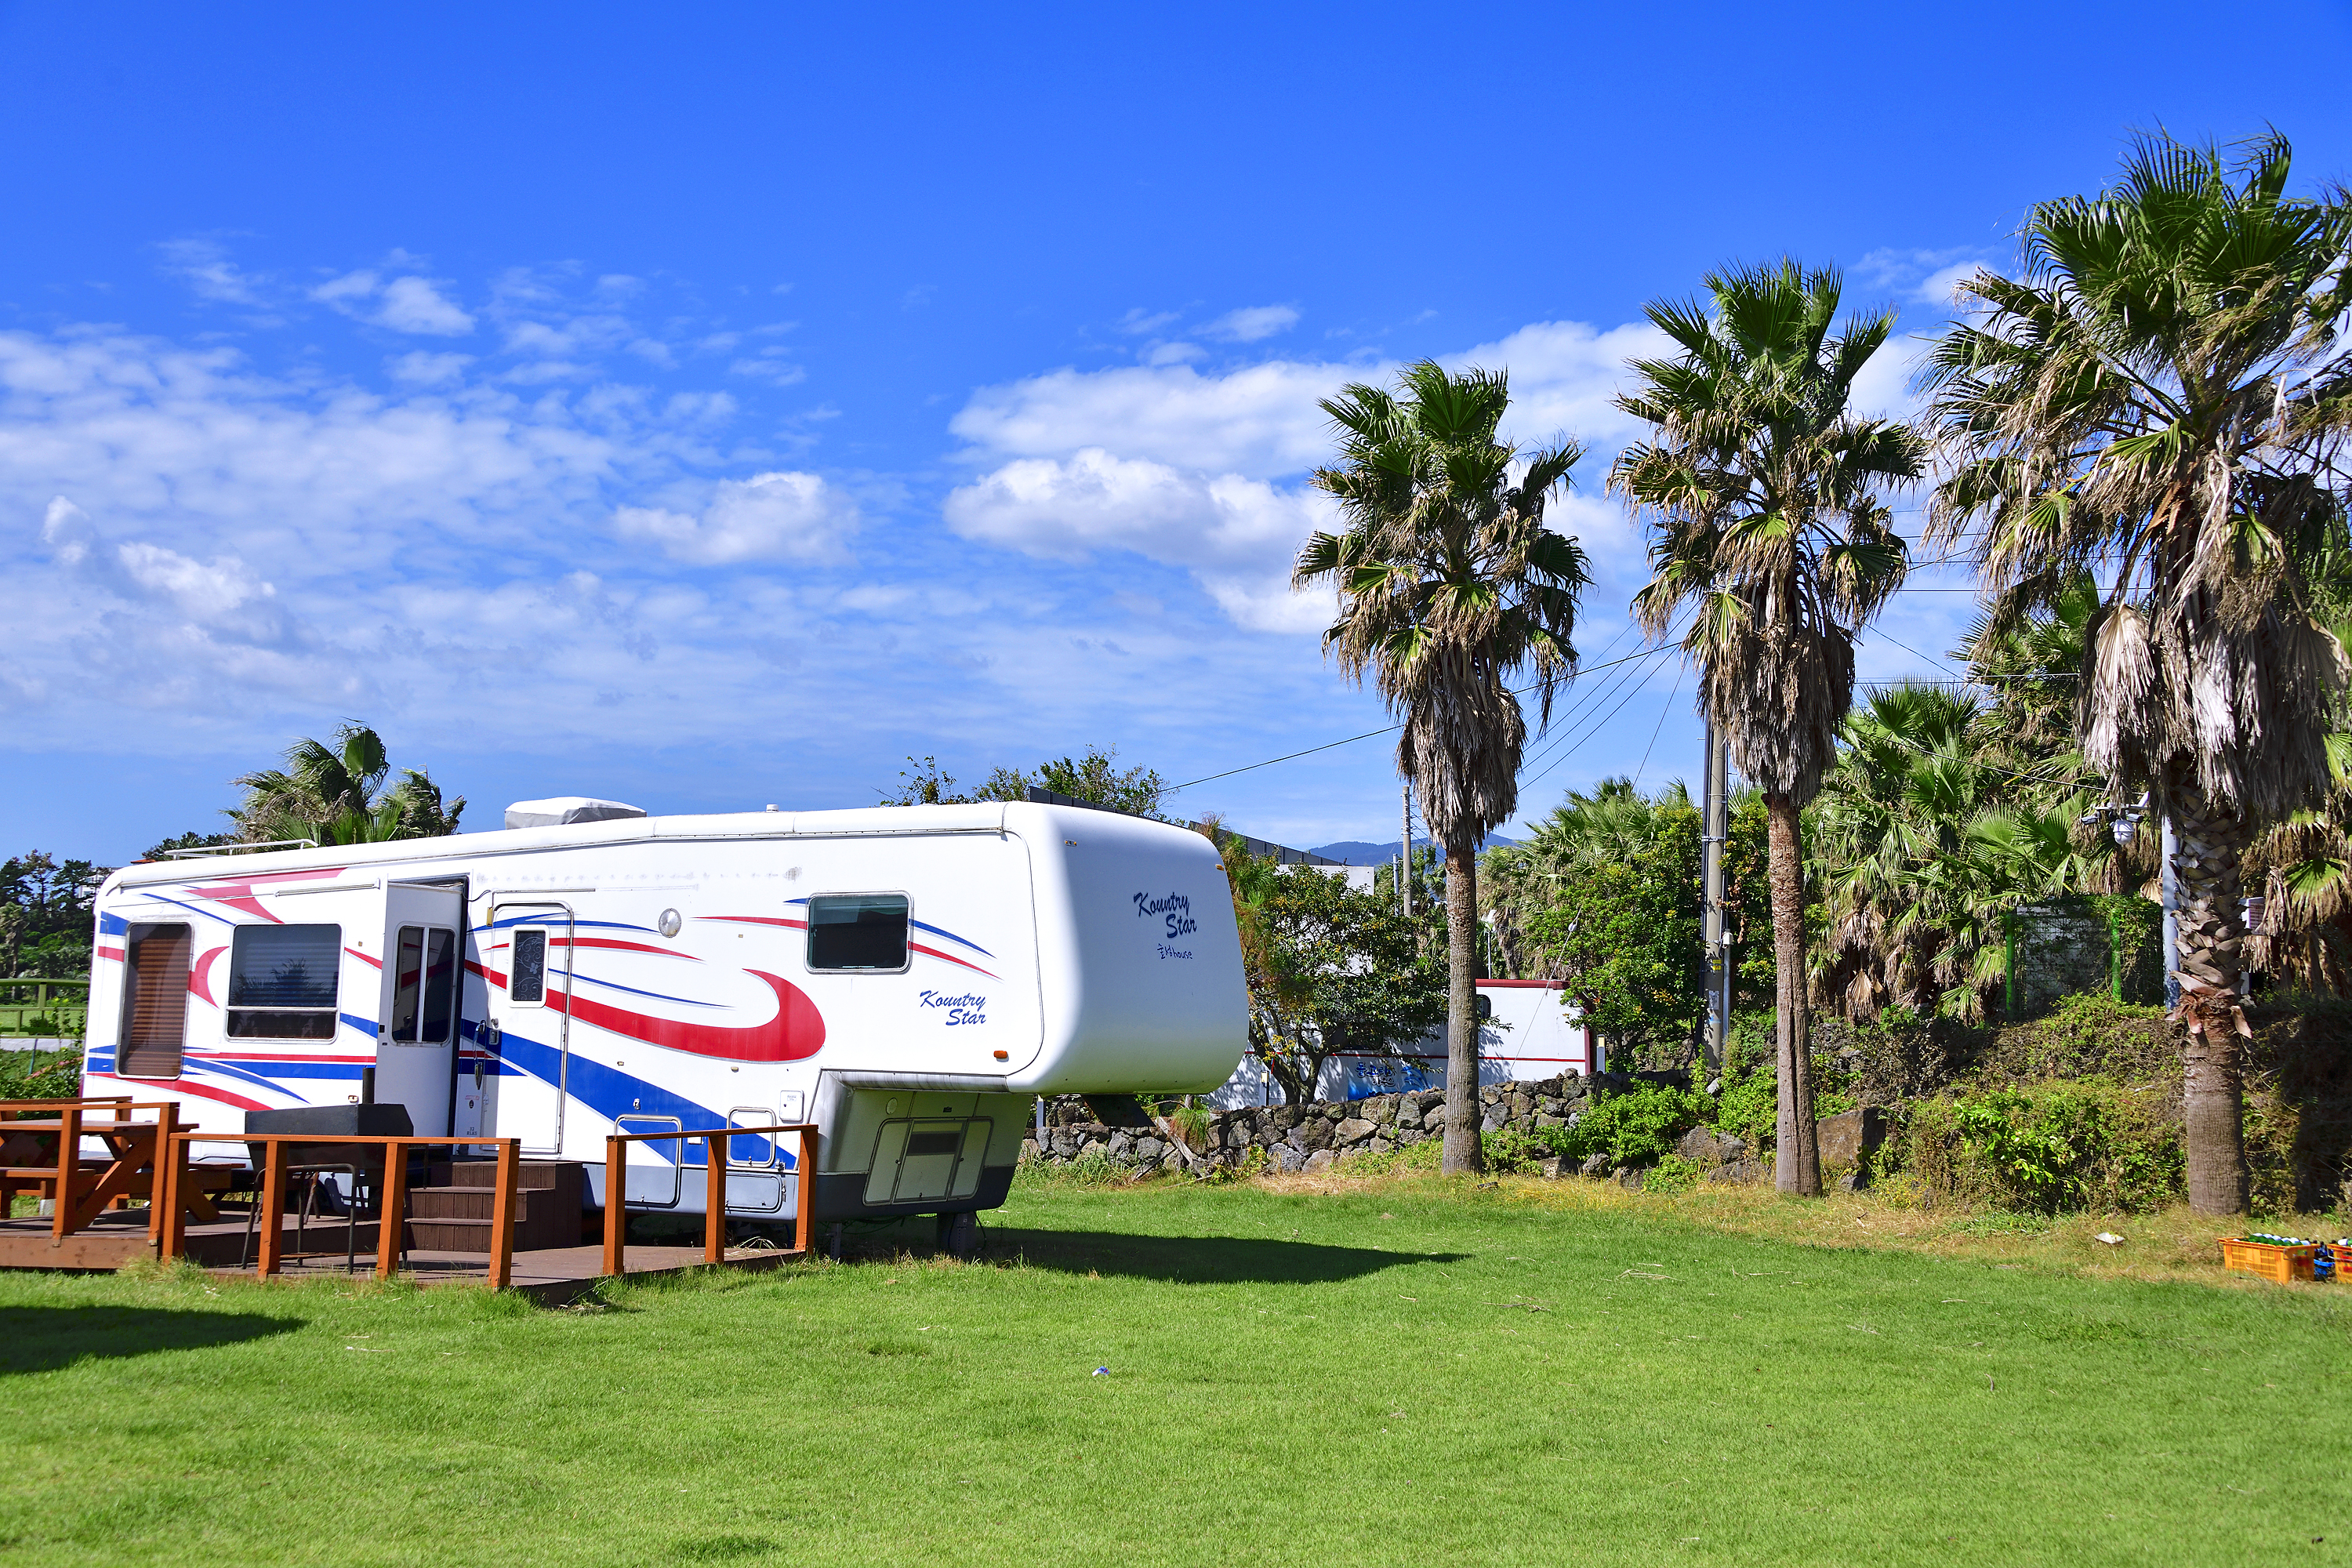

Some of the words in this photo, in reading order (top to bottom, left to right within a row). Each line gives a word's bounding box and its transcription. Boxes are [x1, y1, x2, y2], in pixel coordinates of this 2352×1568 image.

[1134, 891, 1190, 917] Kountry
[1166, 913, 1197, 938] Star
[920, 989, 986, 1012] Kountry
[946, 1008, 986, 1026] Star
